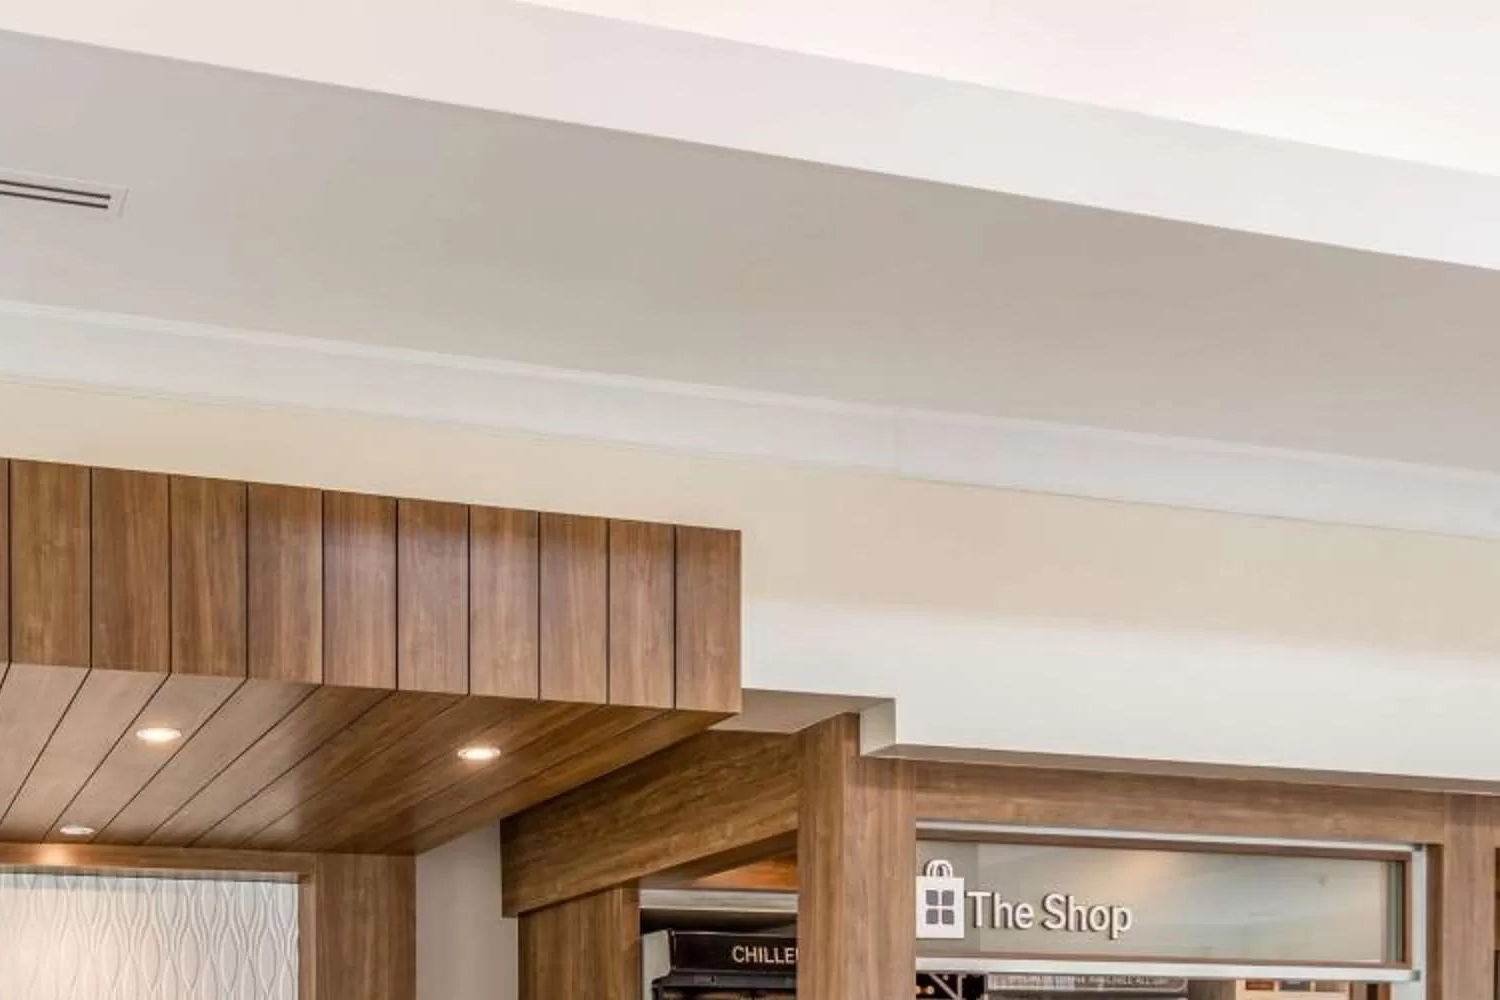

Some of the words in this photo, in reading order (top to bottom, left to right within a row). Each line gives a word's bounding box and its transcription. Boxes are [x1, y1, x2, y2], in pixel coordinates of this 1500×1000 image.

[965, 891, 1035, 929] The
[1042, 892, 1133, 939] Shop
[731, 945, 799, 964] CHILLE
